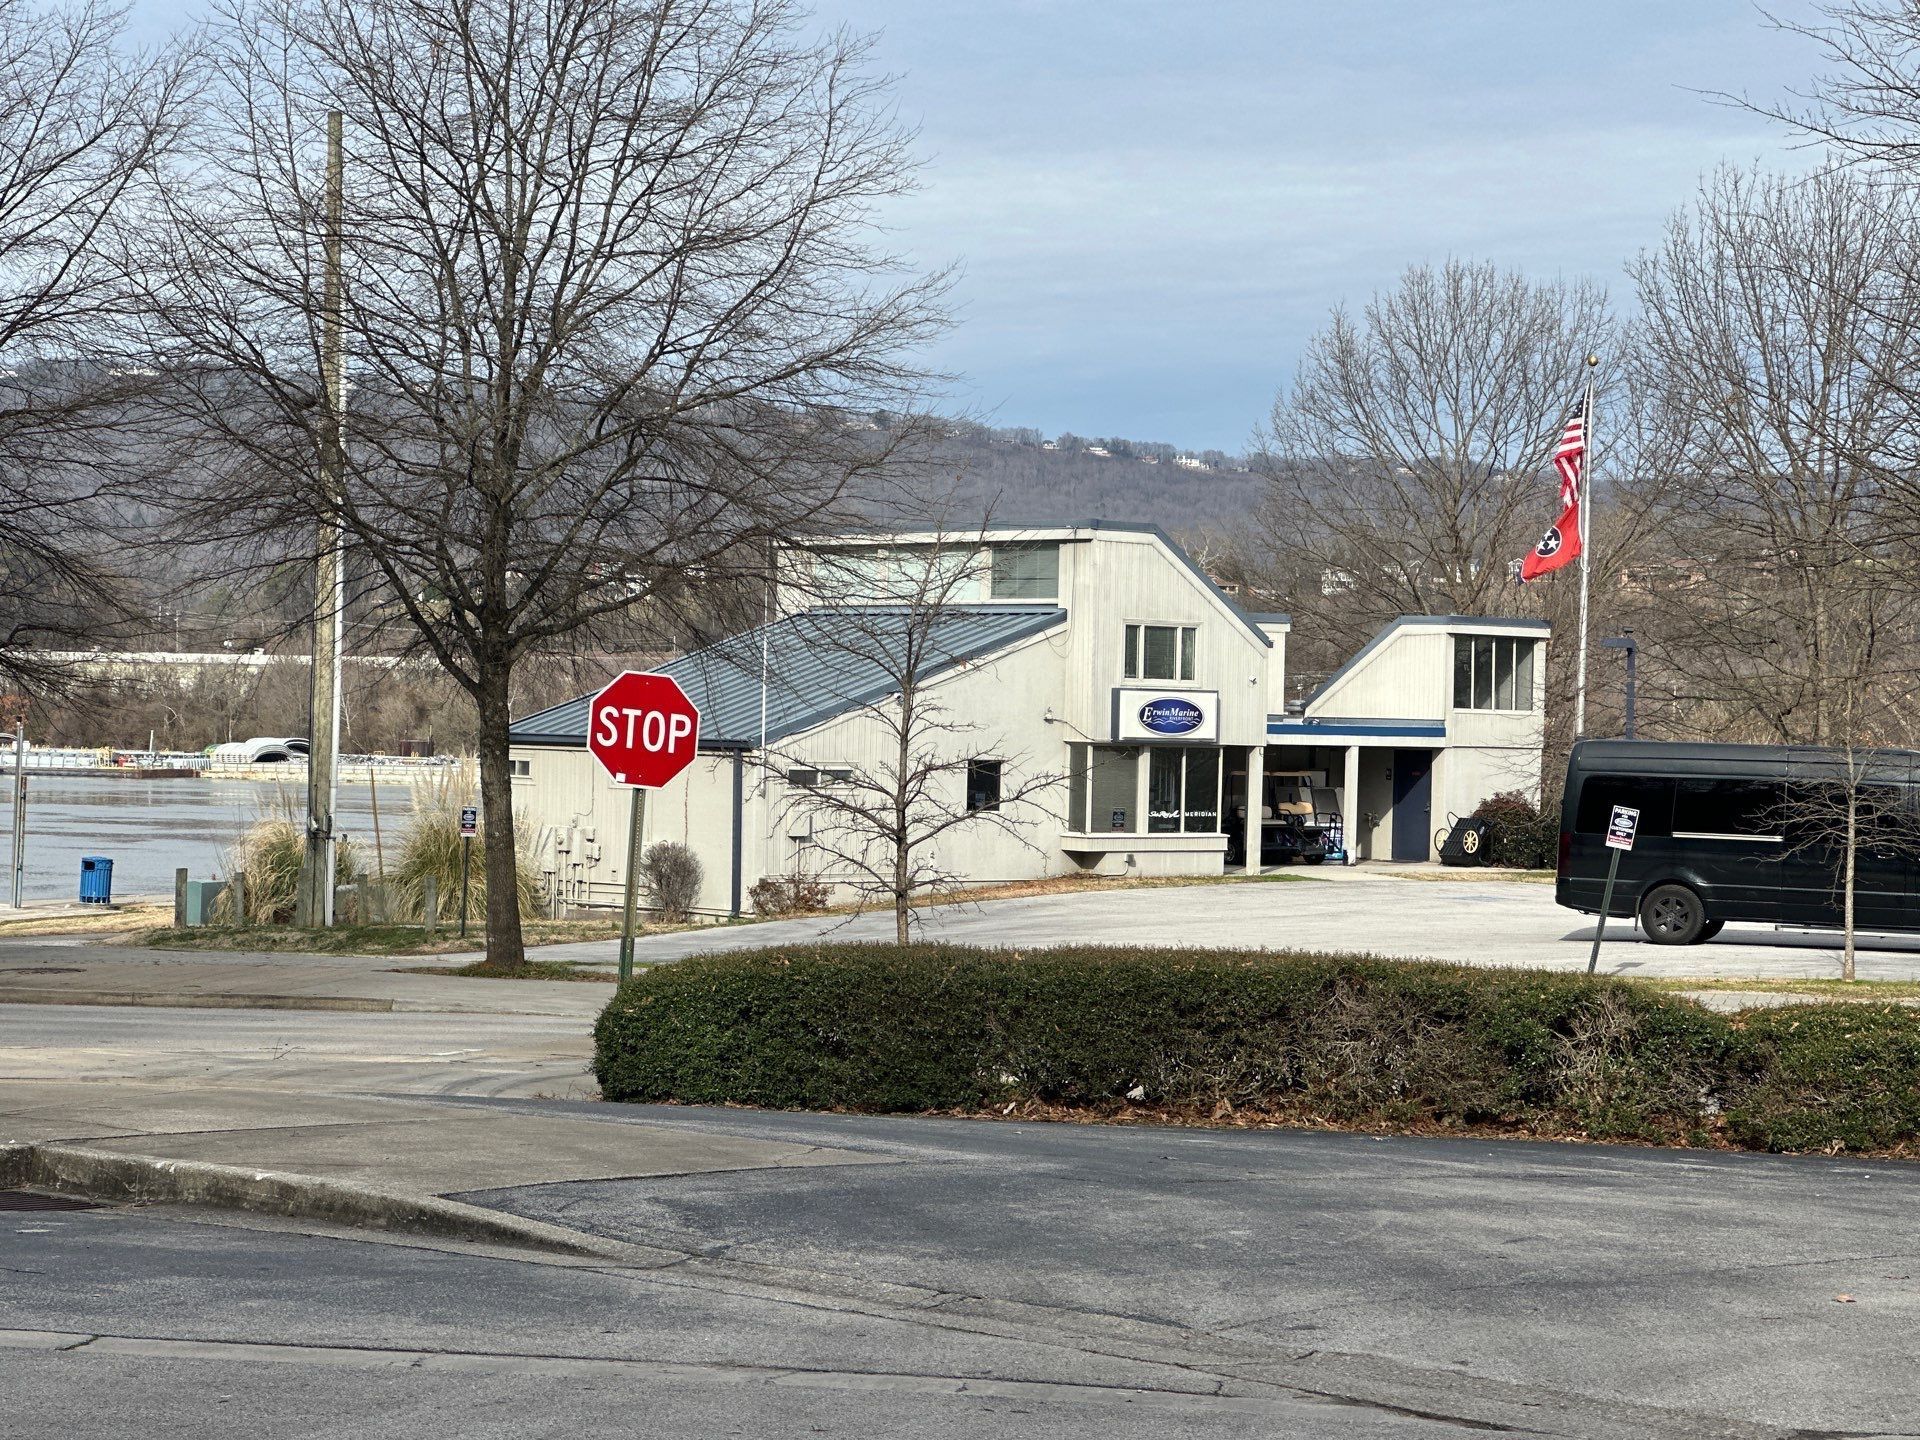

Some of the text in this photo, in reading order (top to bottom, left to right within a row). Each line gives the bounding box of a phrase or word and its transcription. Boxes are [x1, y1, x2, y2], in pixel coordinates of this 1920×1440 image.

[1143, 706, 1199, 721] Erwin Marine
[596, 705, 692, 754] STOP
[1615, 807, 1637, 817] PARKING
